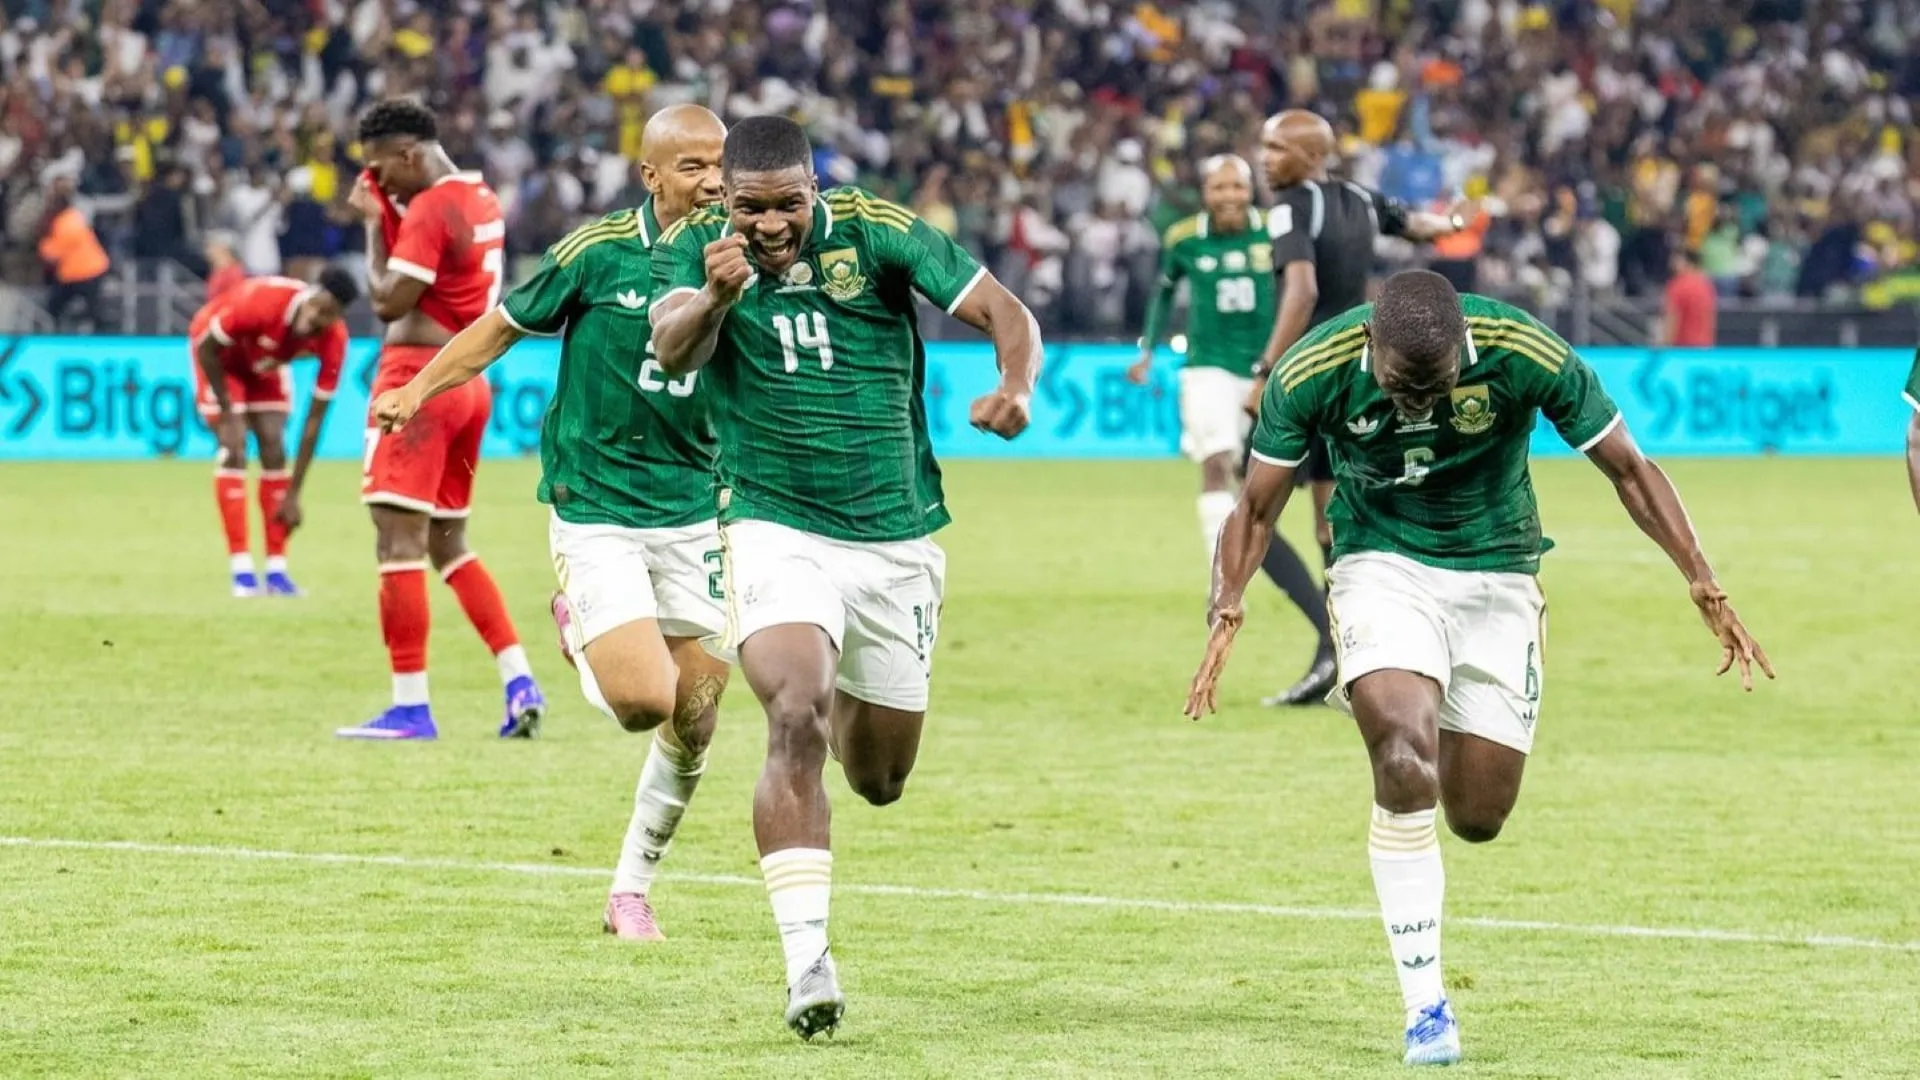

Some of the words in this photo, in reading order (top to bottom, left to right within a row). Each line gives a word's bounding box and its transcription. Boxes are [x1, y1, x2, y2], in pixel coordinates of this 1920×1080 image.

[1216, 276, 1256, 313] 20
[772, 311, 834, 373] 14
[60, 363, 200, 455] Bitg
[703, 550, 725, 599] 2
[913, 600, 934, 649] 14
[1525, 641, 1539, 701] 6
[1391, 919, 1437, 935] SAFA
